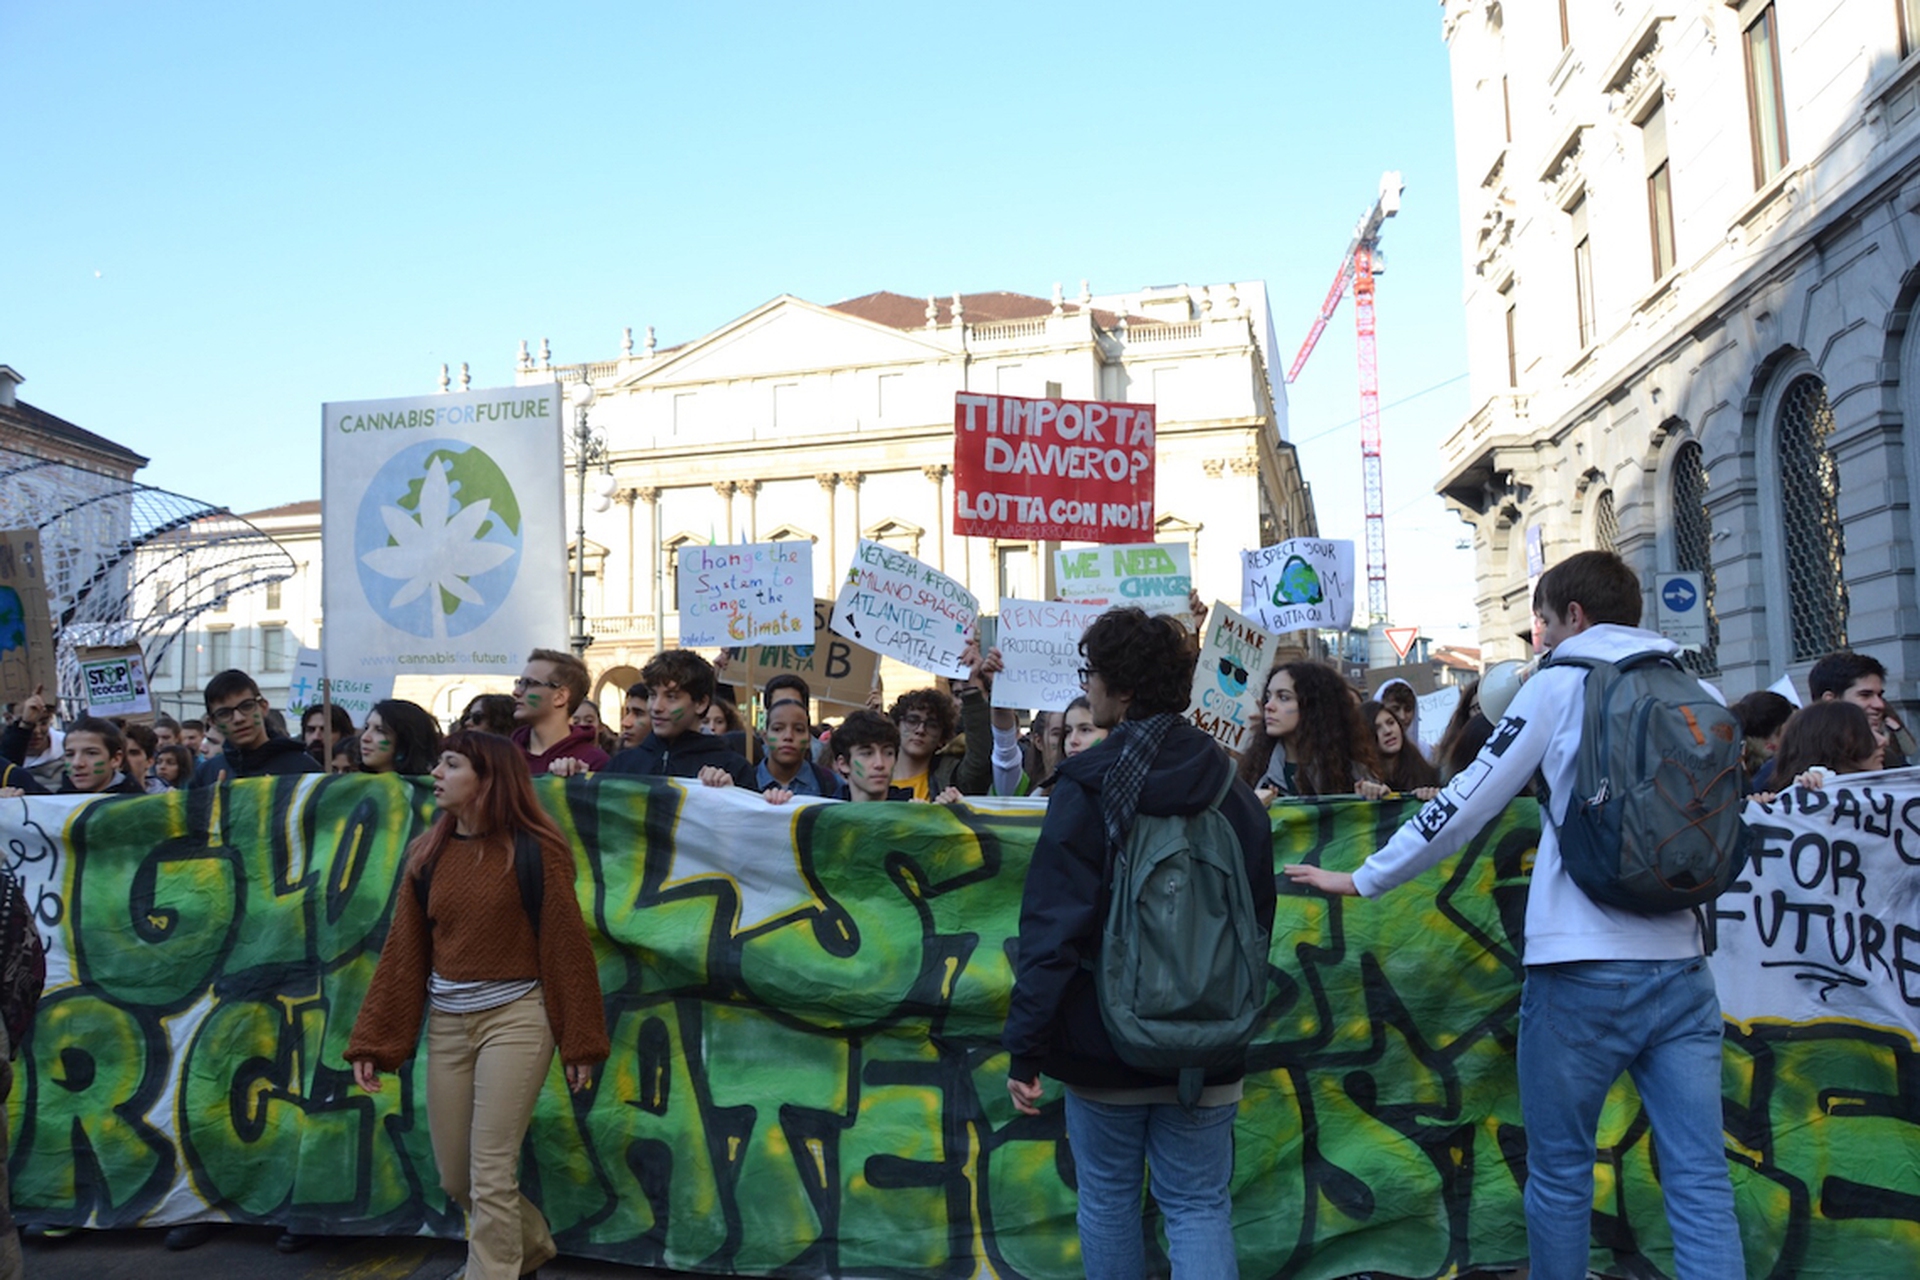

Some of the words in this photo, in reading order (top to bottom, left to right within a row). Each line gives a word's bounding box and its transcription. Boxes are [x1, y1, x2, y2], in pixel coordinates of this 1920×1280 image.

[340, 398, 550, 433] CANNABISFORFUTURE
[956, 393, 998, 433] TI
[1003, 397, 1155, 447] IMPORTA
[985, 437, 1150, 485] DAVVERO?
[957, 489, 1047, 523] LOTTA
[1049, 498, 1097, 525] CON
[685, 549, 763, 573] Change
[769, 543, 798, 562] the
[1060, 551, 1101, 580] WE
[1113, 547, 1177, 577] NEED
[1247, 541, 1297, 569] RESPECT
[1303, 541, 1337, 560] YOUR
[773, 565, 794, 588] to
[858, 569, 913, 602] MILANO
[859, 542, 919, 579] VENEZIA
[920, 570, 975, 612] AFFONDA
[690, 593, 747, 618] change
[755, 587, 783, 605] the
[847, 591, 940, 639] ATLANTIDE
[1273, 609, 1305, 629] BUTTA
[1002, 637, 1075, 657] PROTOCOLLO
[1213, 625, 1264, 671] EARTH
[1223, 615, 1267, 650] MAKE
[825, 641, 852, 679] B
[91, 683, 129, 696] ECOCIDE
[1202, 688, 1245, 726] COOL
[1187, 707, 1246, 748] AGAIN
[1747, 822, 1867, 908] FOR
